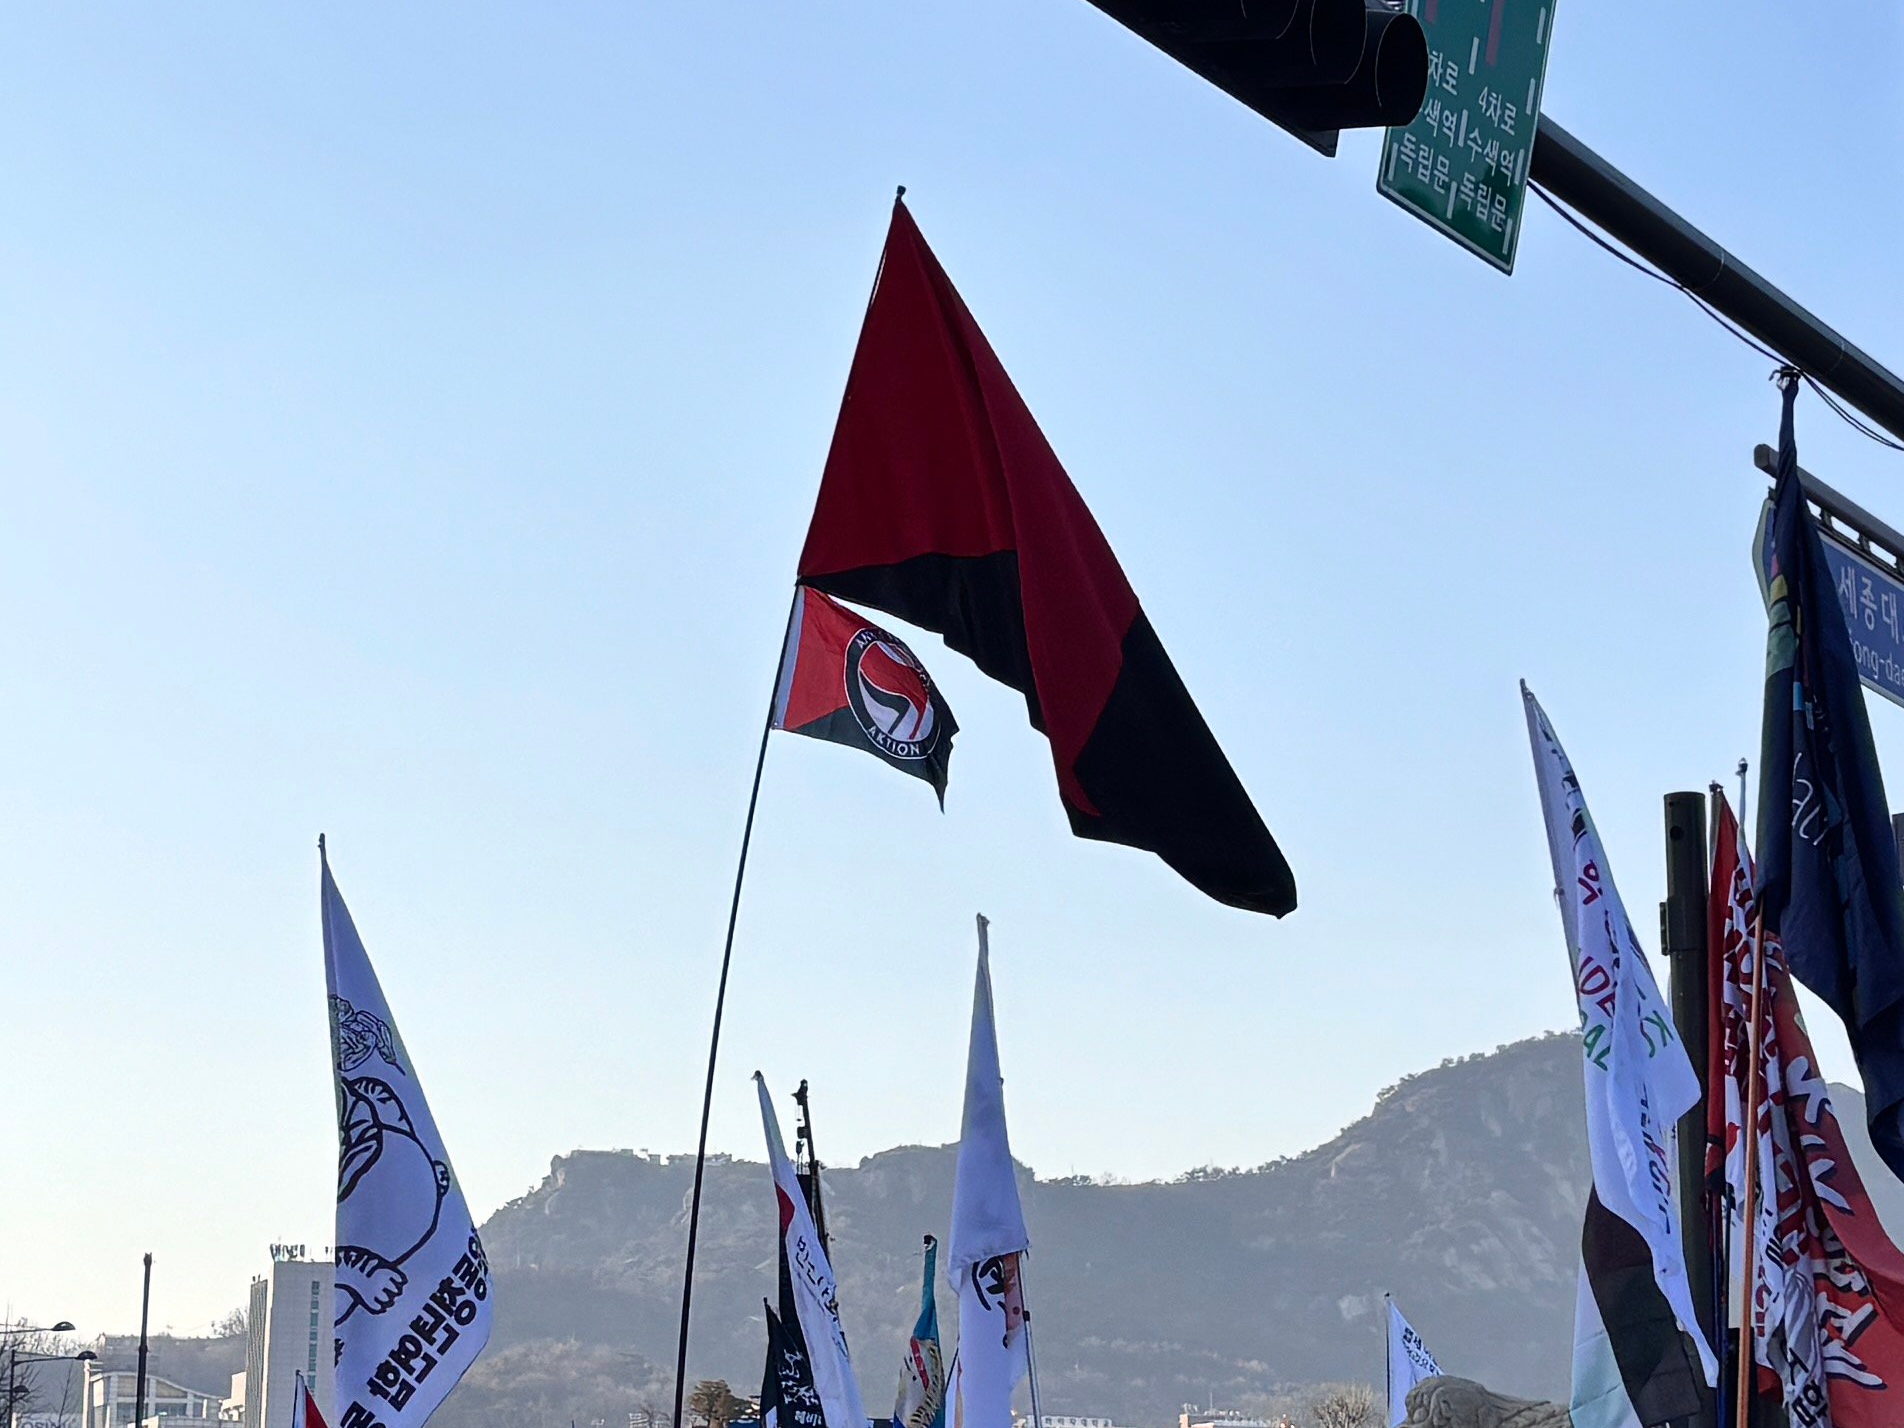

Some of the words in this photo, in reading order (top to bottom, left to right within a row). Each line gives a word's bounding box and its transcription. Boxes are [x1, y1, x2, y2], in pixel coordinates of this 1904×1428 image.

[1428, 50, 1459, 96] 차로
[1420, 98, 1457, 149] 색역
[1478, 86, 1517, 136] 4차로
[1399, 132, 1450, 195] 독립문
[1466, 127, 1516, 187] 수색역
[1459, 171, 1507, 233] 독립문
